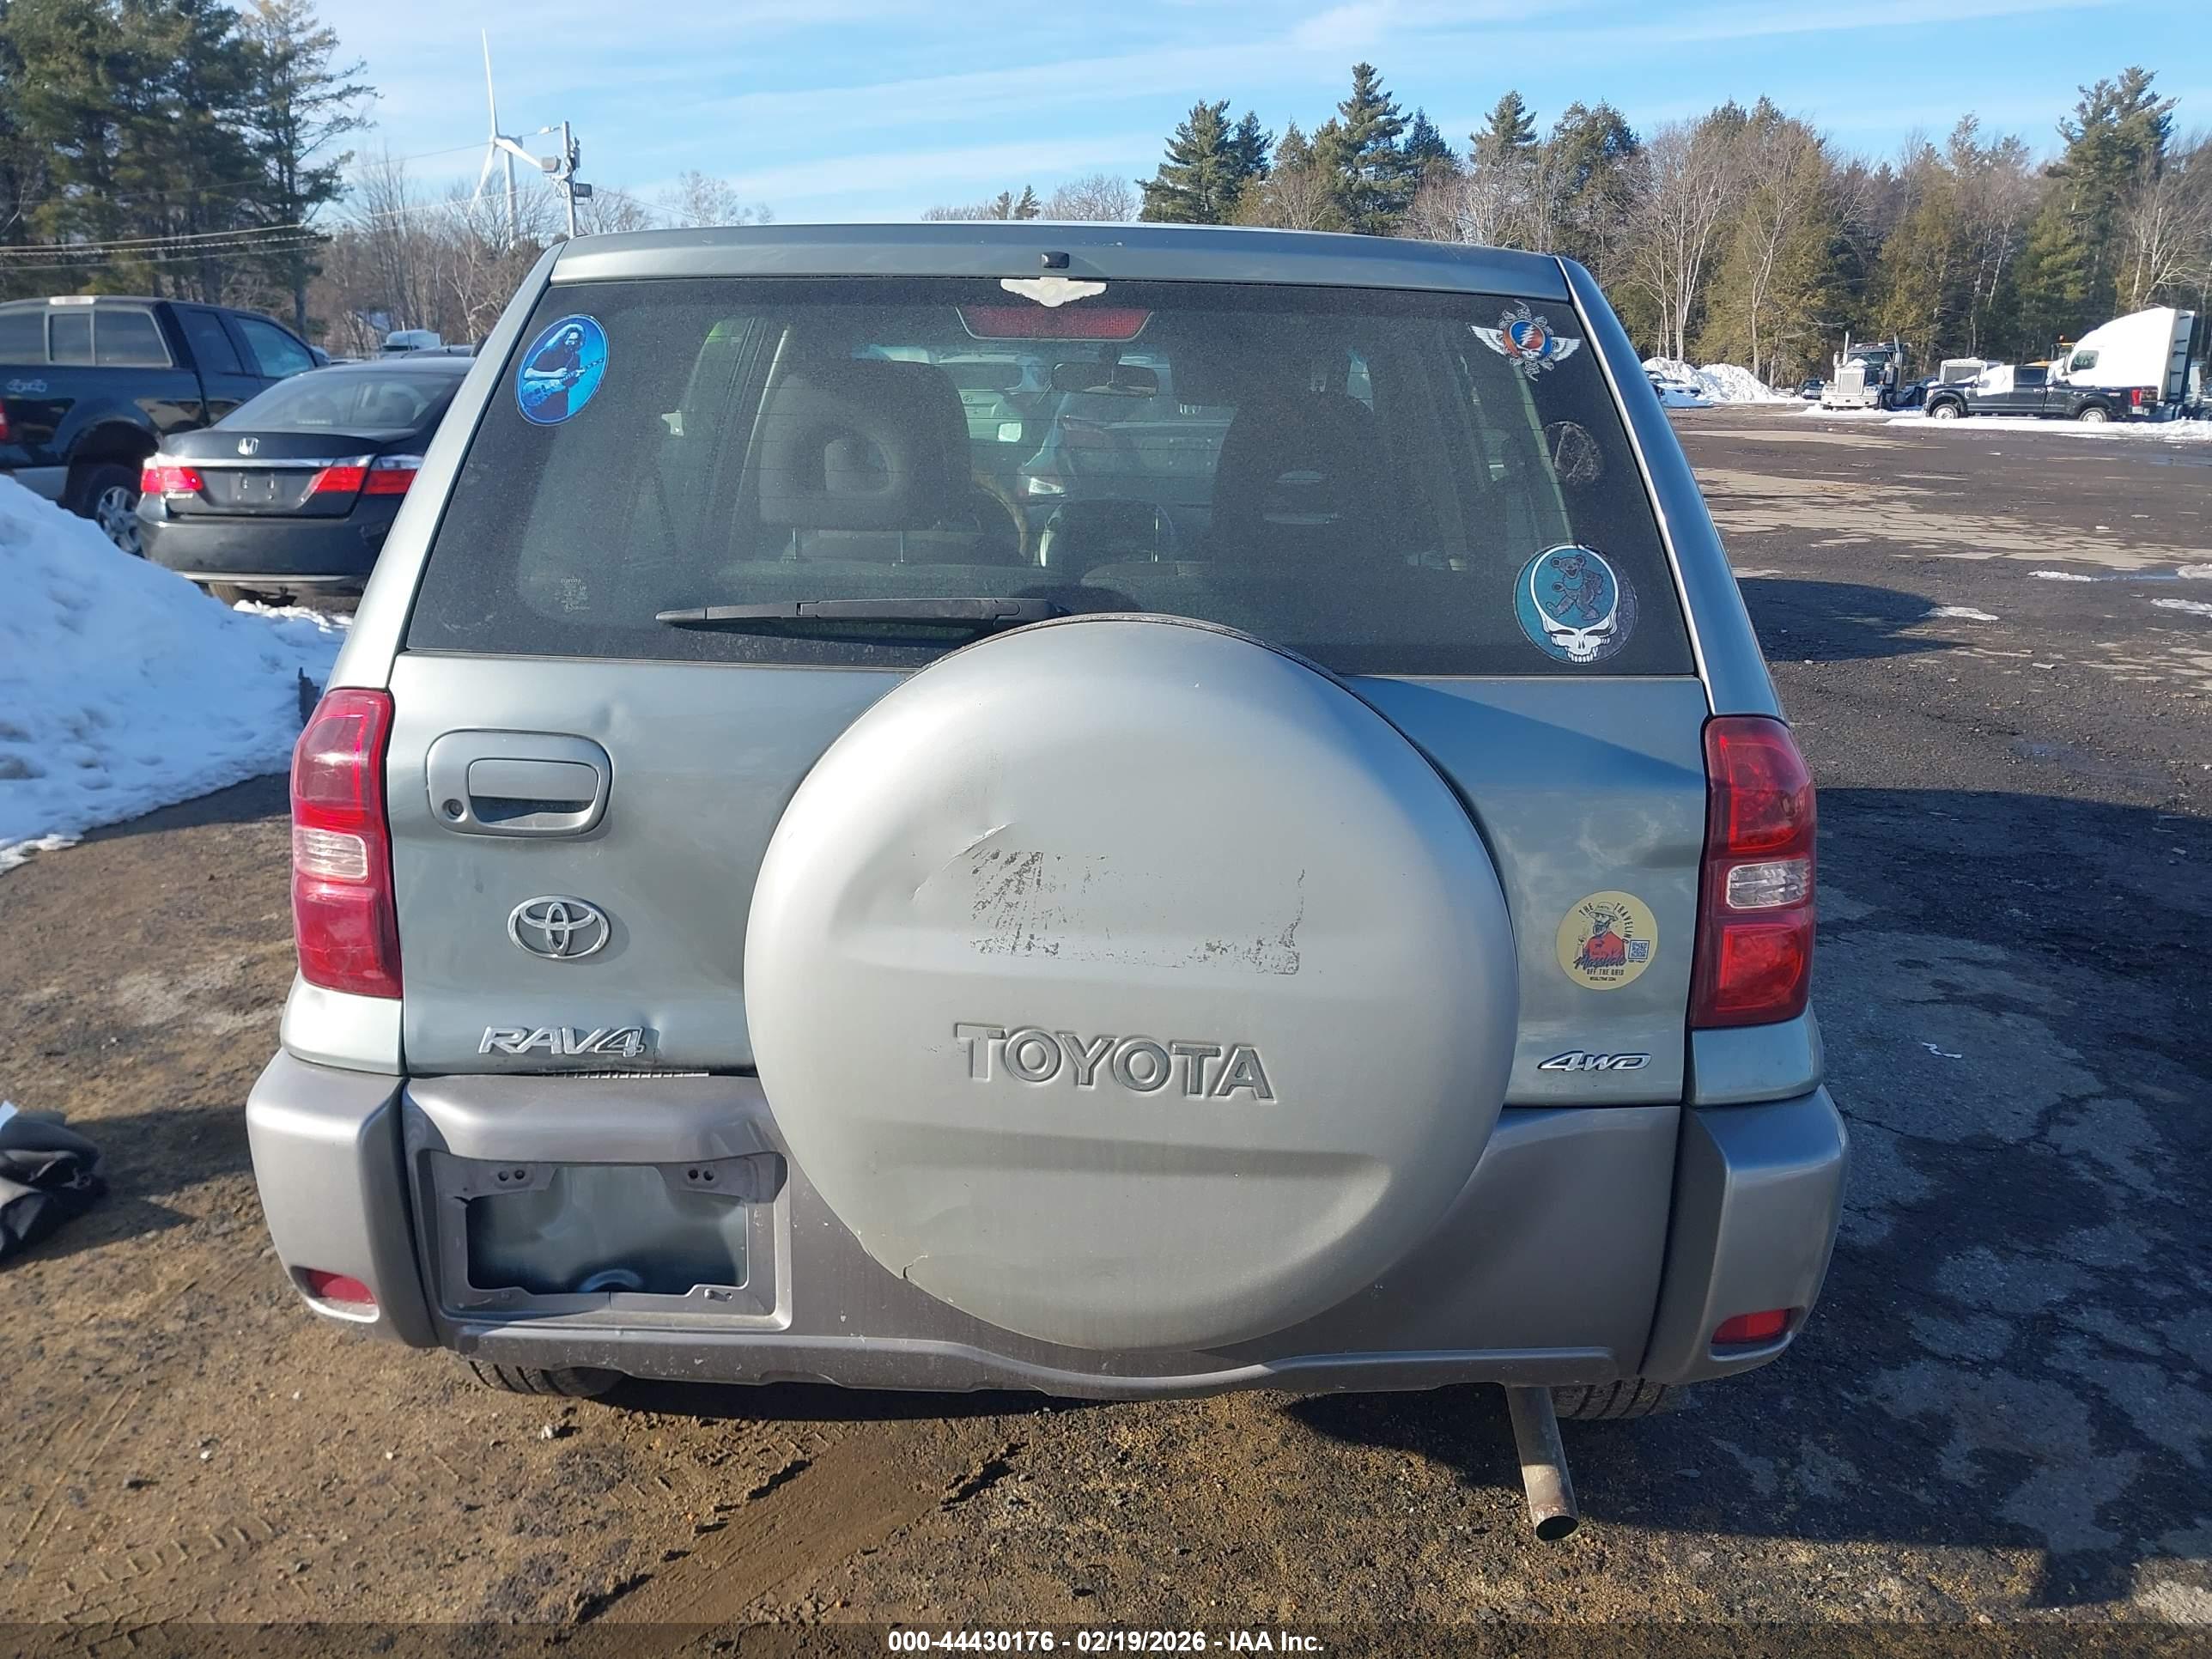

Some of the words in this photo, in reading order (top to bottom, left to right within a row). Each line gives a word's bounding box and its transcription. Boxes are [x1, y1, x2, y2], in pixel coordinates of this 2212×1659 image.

[1578, 902, 1595, 916] THE
[1613, 902, 1634, 944] TRAVELING
[478, 1026, 644, 1058] RAV4
[955, 1024, 1277, 1103] TOYOTA
[1537, 1050, 1652, 1072] 4WD
